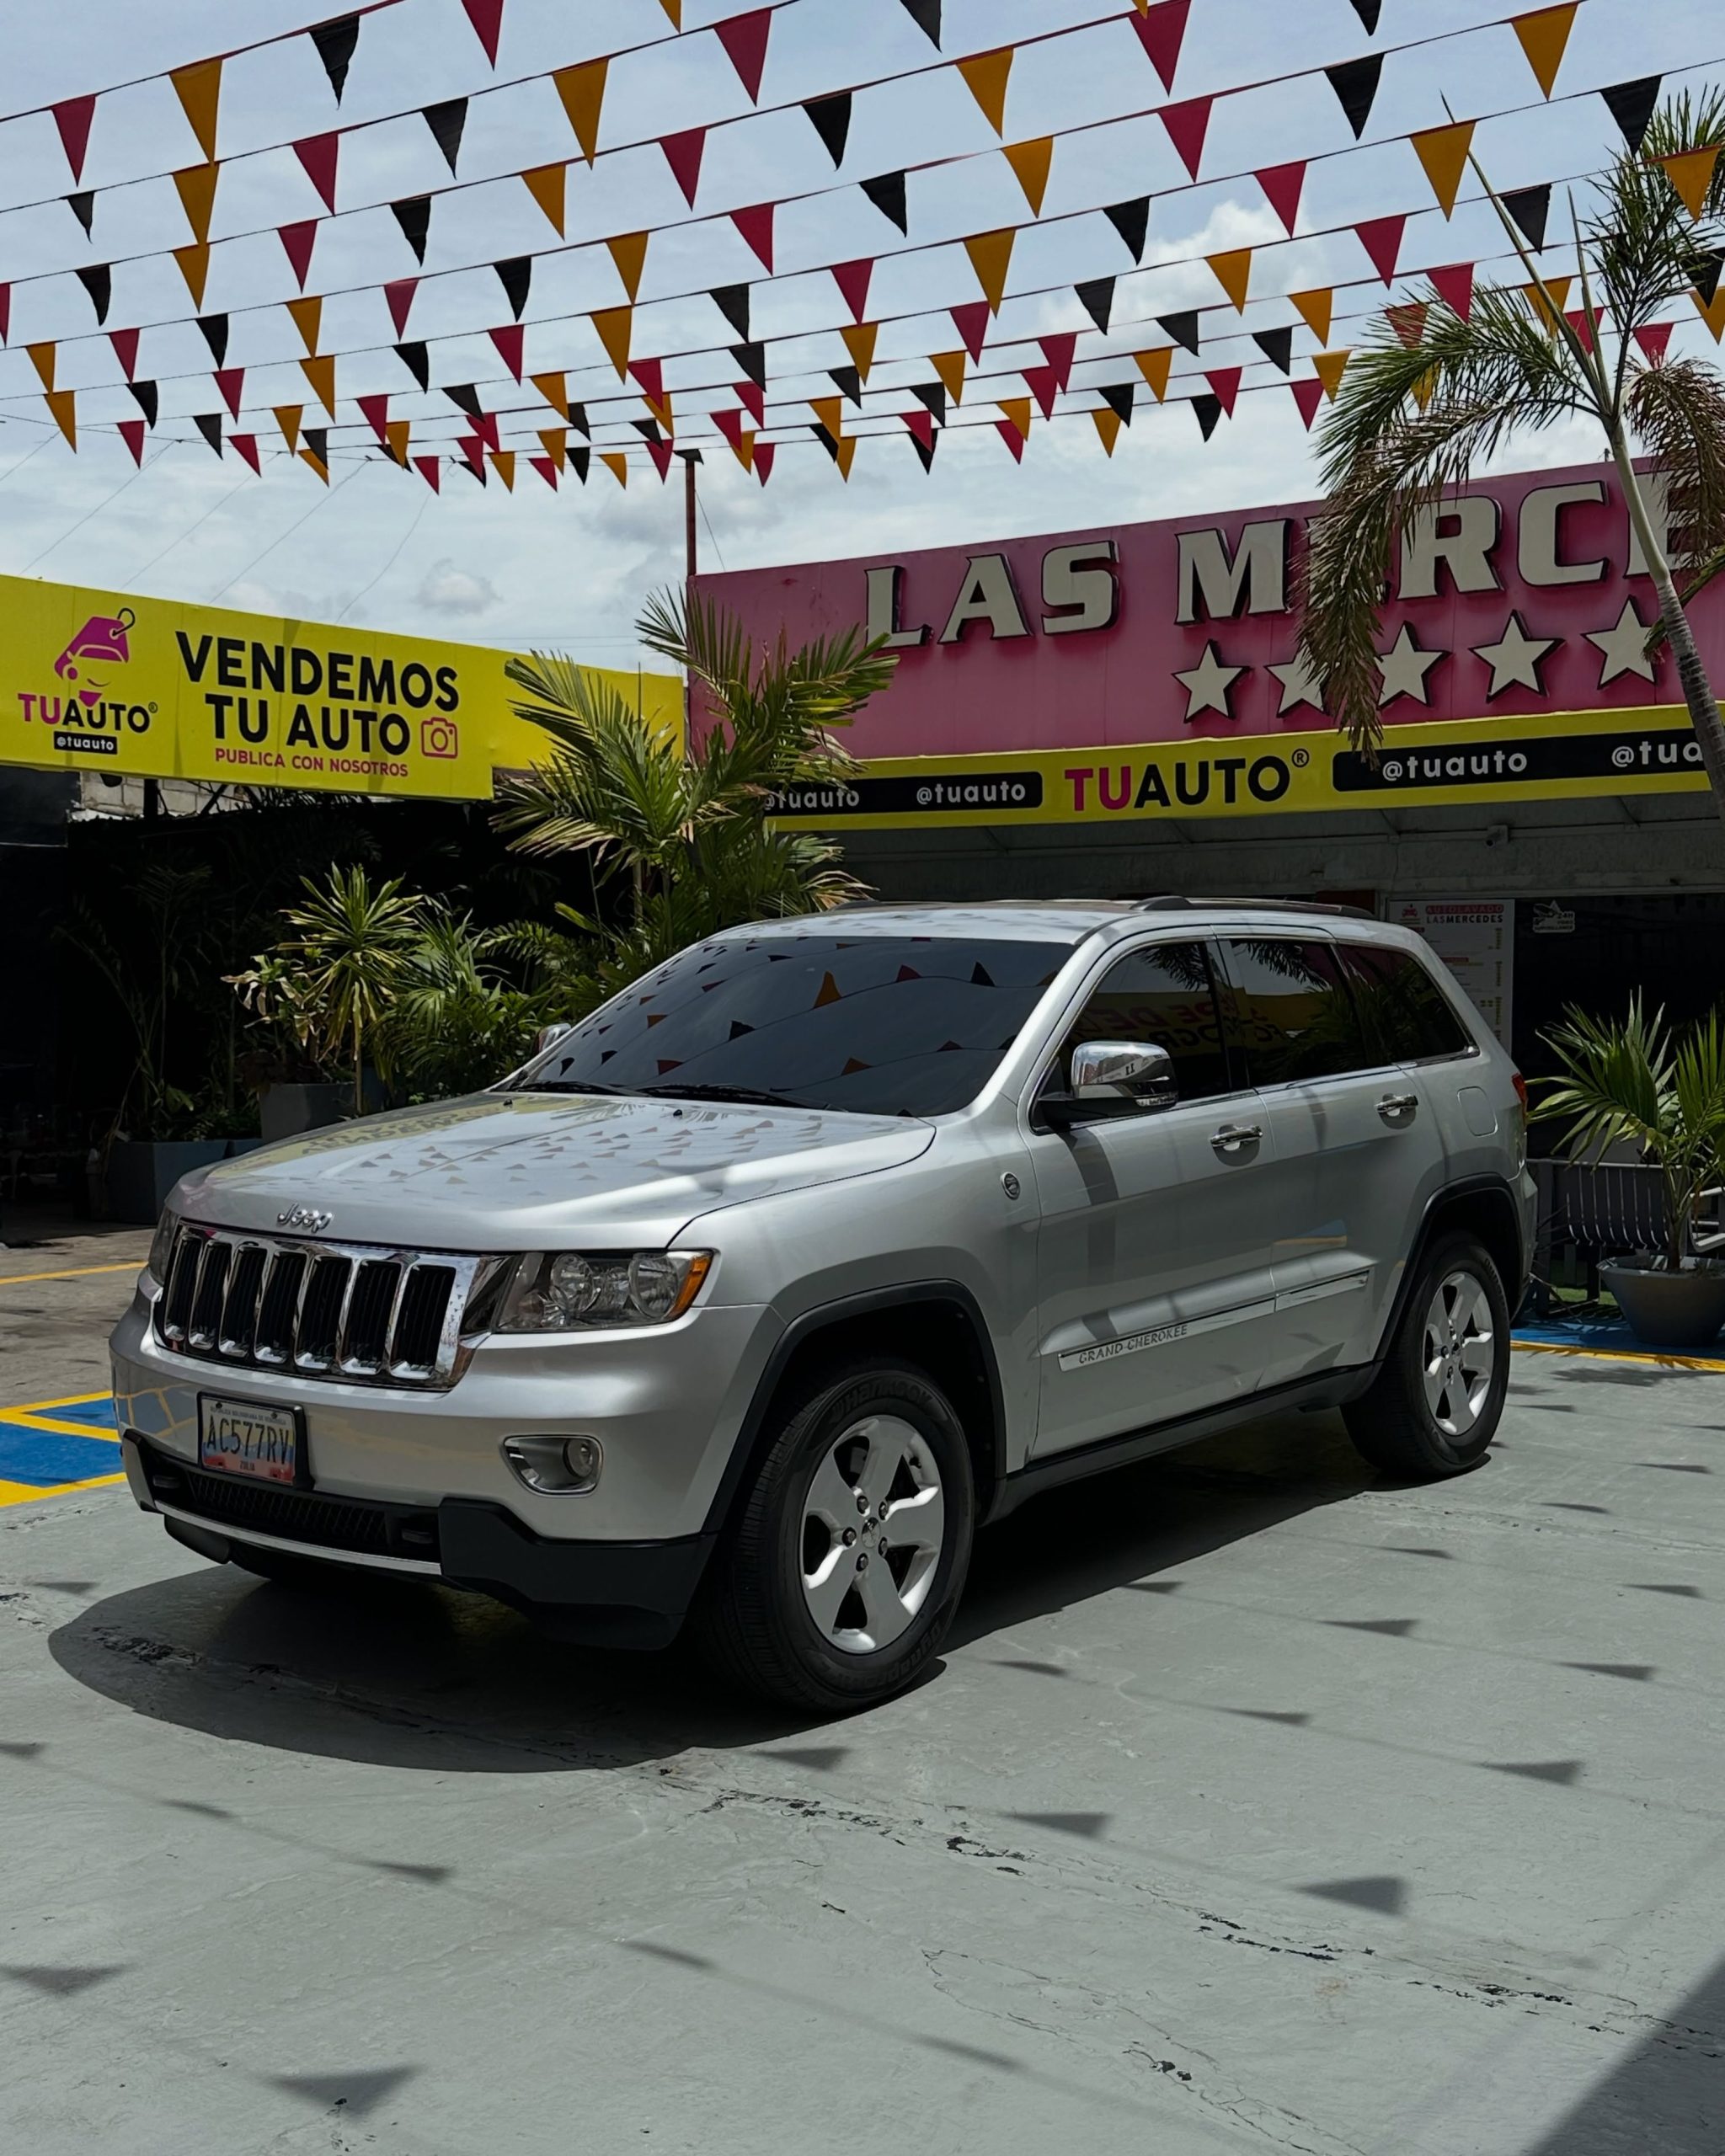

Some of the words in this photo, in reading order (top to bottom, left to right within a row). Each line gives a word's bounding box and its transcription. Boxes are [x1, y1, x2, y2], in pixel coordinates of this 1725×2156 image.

[865, 539, 1119, 648] LAS
[1176, 469, 1715, 627] MRCE
[175, 629, 459, 712] VENDEMOS
[205, 692, 269, 744] TU
[286, 704, 411, 756] AUTO
[56, 736, 115, 751] @tuauto
[215, 747, 285, 768] PUBLICA
[291, 753, 325, 771] CON
[329, 756, 409, 778] NOSOTROS
[1382, 750, 1528, 782] @tuauto
[916, 781, 1027, 806] @tuauto
[1427, 905, 1503, 914] AUTOLAVADO
[276, 1202, 334, 1234] Jeep
[1079, 1343, 1124, 1364] GRAND
[1127, 1325, 1188, 1351] CHEROKEE
[206, 1415, 290, 1465] AC577RV
